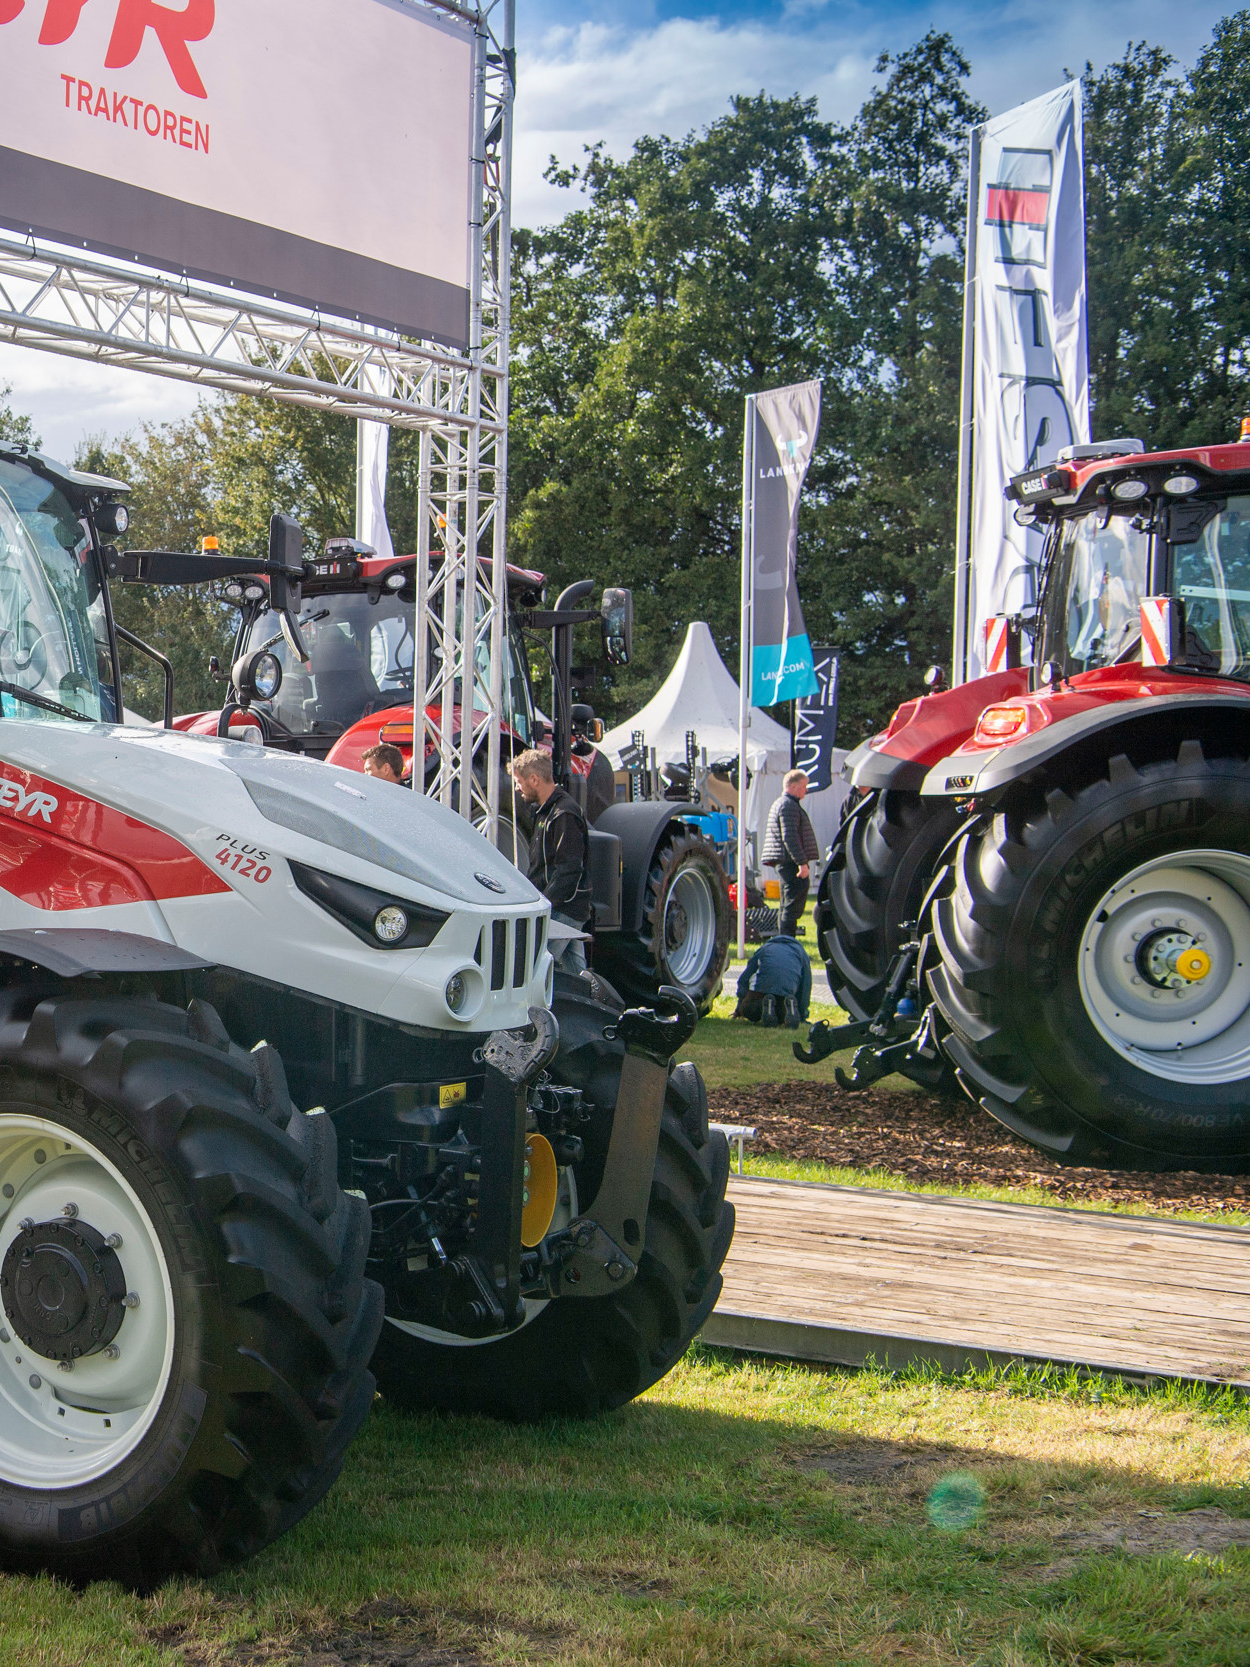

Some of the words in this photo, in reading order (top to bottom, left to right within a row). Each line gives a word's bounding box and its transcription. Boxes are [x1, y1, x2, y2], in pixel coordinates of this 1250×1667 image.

[60, 73, 210, 154] TRAKTOREN
[1021, 477, 1042, 496] CASE
[214, 847, 273, 884] 4120
[216, 833, 271, 860] PLUS
[1038, 799, 1189, 930] MICHELIN
[91, 1106, 199, 1270] MICHELIN
